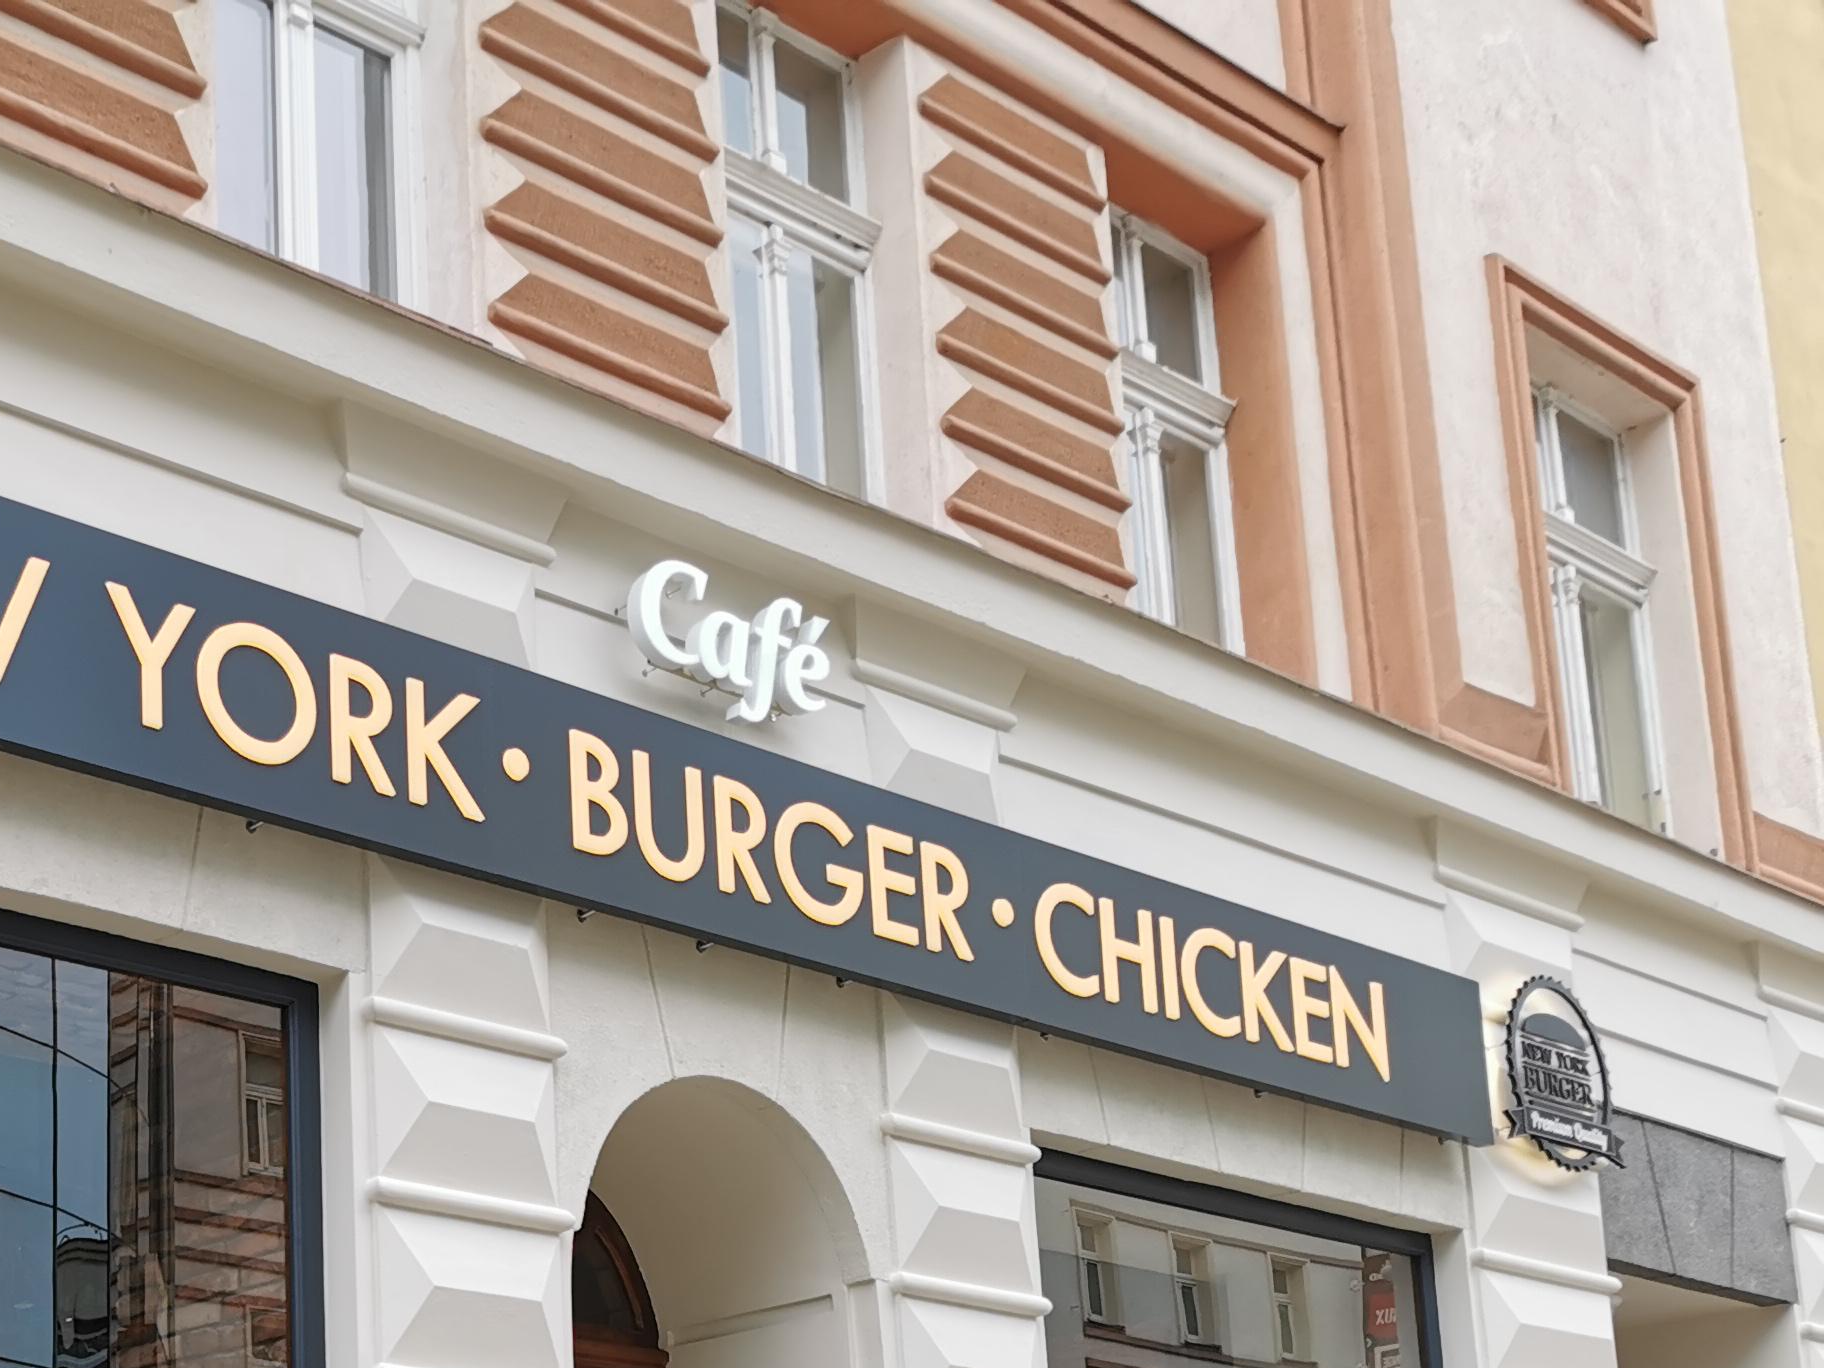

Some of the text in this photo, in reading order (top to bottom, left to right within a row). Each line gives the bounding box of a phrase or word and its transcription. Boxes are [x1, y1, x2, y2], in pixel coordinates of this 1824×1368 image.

[628, 559, 832, 723] Café
[105, 580, 486, 823] YORK
[567, 727, 975, 962] BURGER
[1034, 882, 1391, 1083] CHICKEN
[1521, 1041, 1590, 1076] NEW YORK
[1523, 1066, 1595, 1107] BURGER
